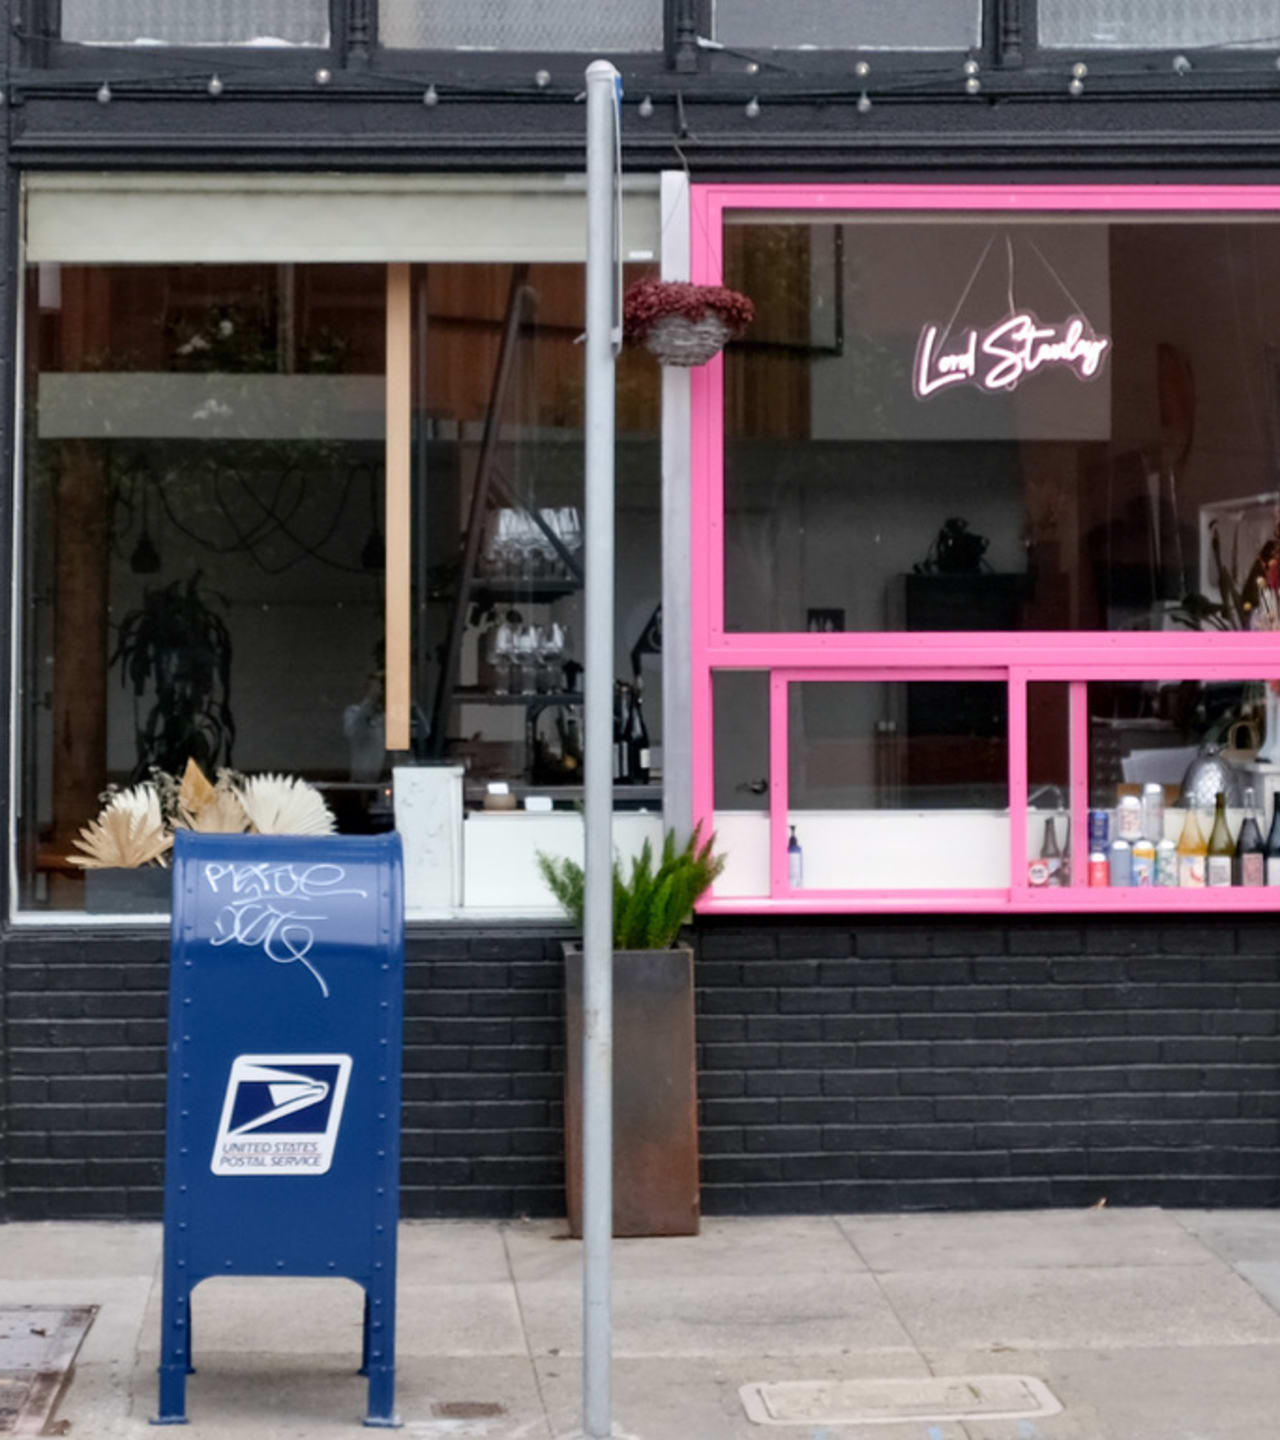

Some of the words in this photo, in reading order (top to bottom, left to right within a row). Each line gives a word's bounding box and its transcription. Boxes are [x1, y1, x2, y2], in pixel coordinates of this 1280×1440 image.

[919, 326, 977, 395] Lord
[982, 315, 1107, 388] Stanley
[222, 1143, 271, 1153] UNITED
[274, 1143, 318, 1153] STATES
[219, 1156, 267, 1167] POSTAL
[270, 1156, 321, 1167] SERVICE
